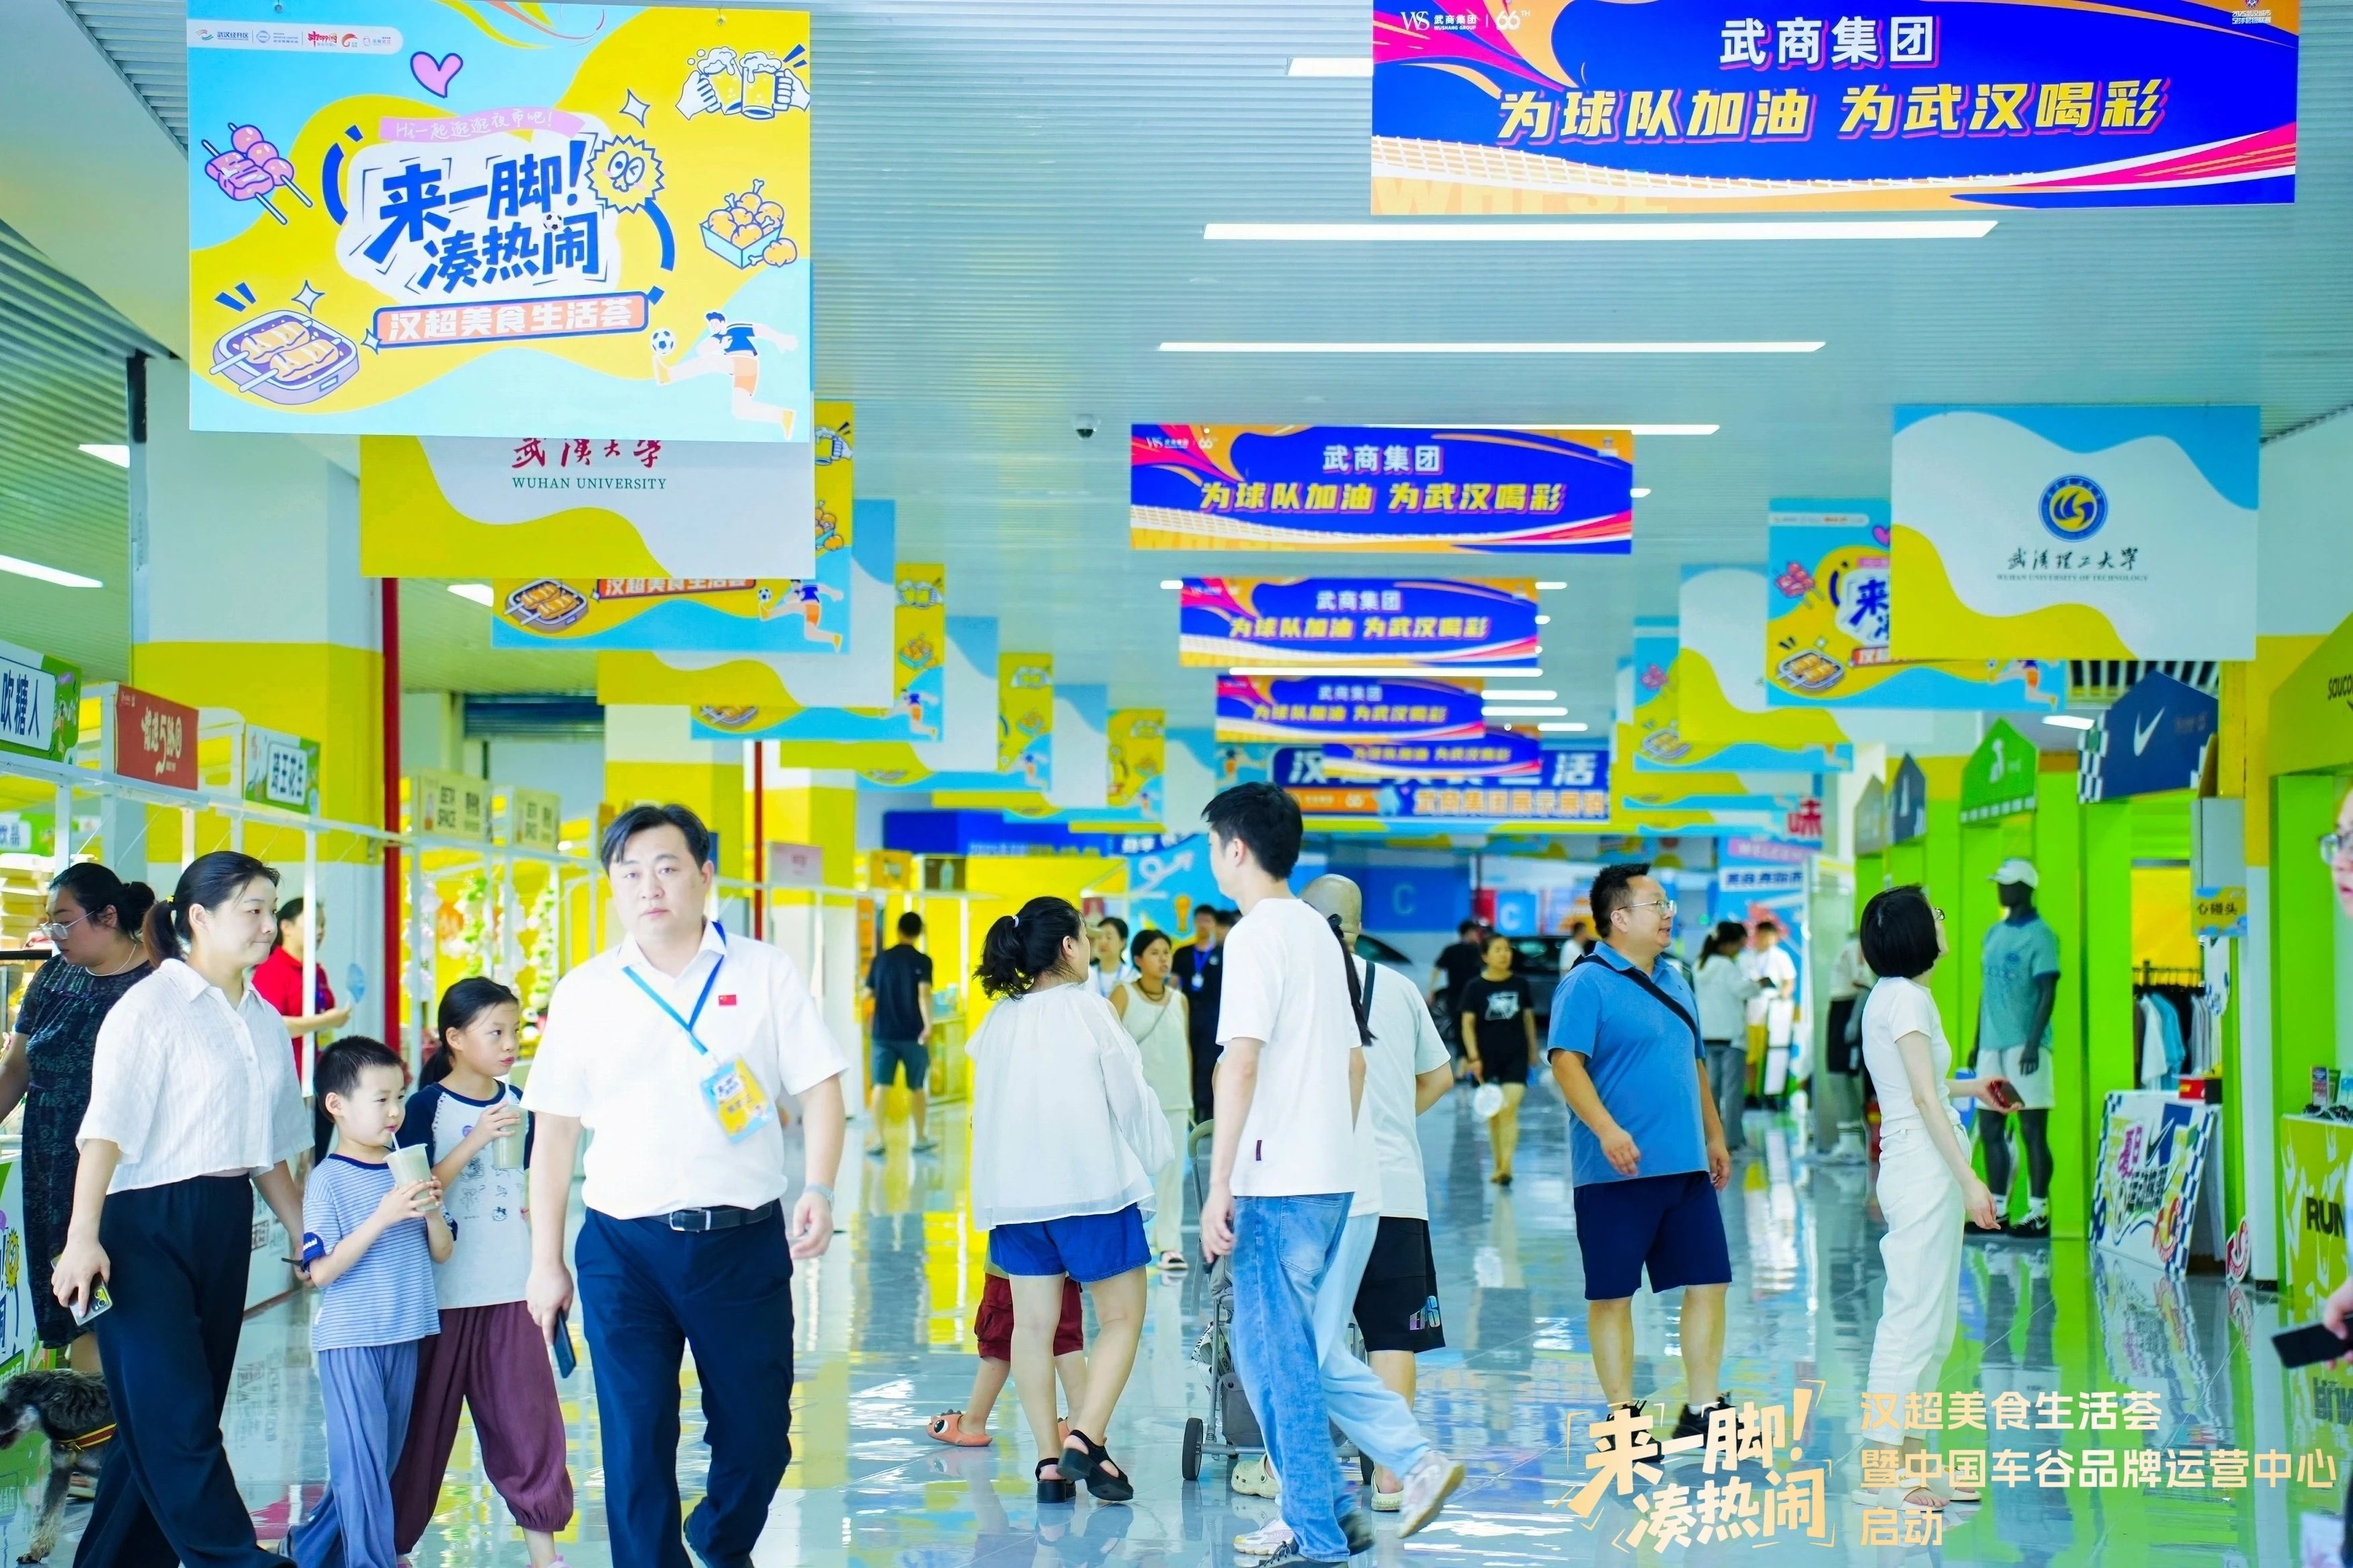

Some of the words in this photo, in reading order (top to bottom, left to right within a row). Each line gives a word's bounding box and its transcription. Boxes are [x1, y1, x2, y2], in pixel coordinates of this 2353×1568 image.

[1434, 15, 1477, 24] 武商集团
[1719, 16, 1934, 65] 武商集团
[1497, 88, 1810, 138] 为球队加油
[1840, 79, 2162, 132] 为武汉喝彩
[417, 211, 600, 294] 凑热闹
[388, 298, 634, 341] 汉超美食生活荟
[1322, 445, 1442, 472] 武商集团
[512, 477, 571, 489] WUHAN
[577, 478, 667, 490] UNIVERSITY
[1200, 482, 1374, 511] 为球队加油
[1388, 482, 1563, 511] 为武汉喝彩
[1996, 573, 2027, 581] WUHAN
[2092, 574, 2149, 582] TECHNOLOGY
[1317, 590, 1401, 612] 武商集团
[1229, 617, 1354, 638] 为球队加油
[1363, 616, 1491, 638] 为武汉喝彩
[2327, 674, 2353, 700] sauco
